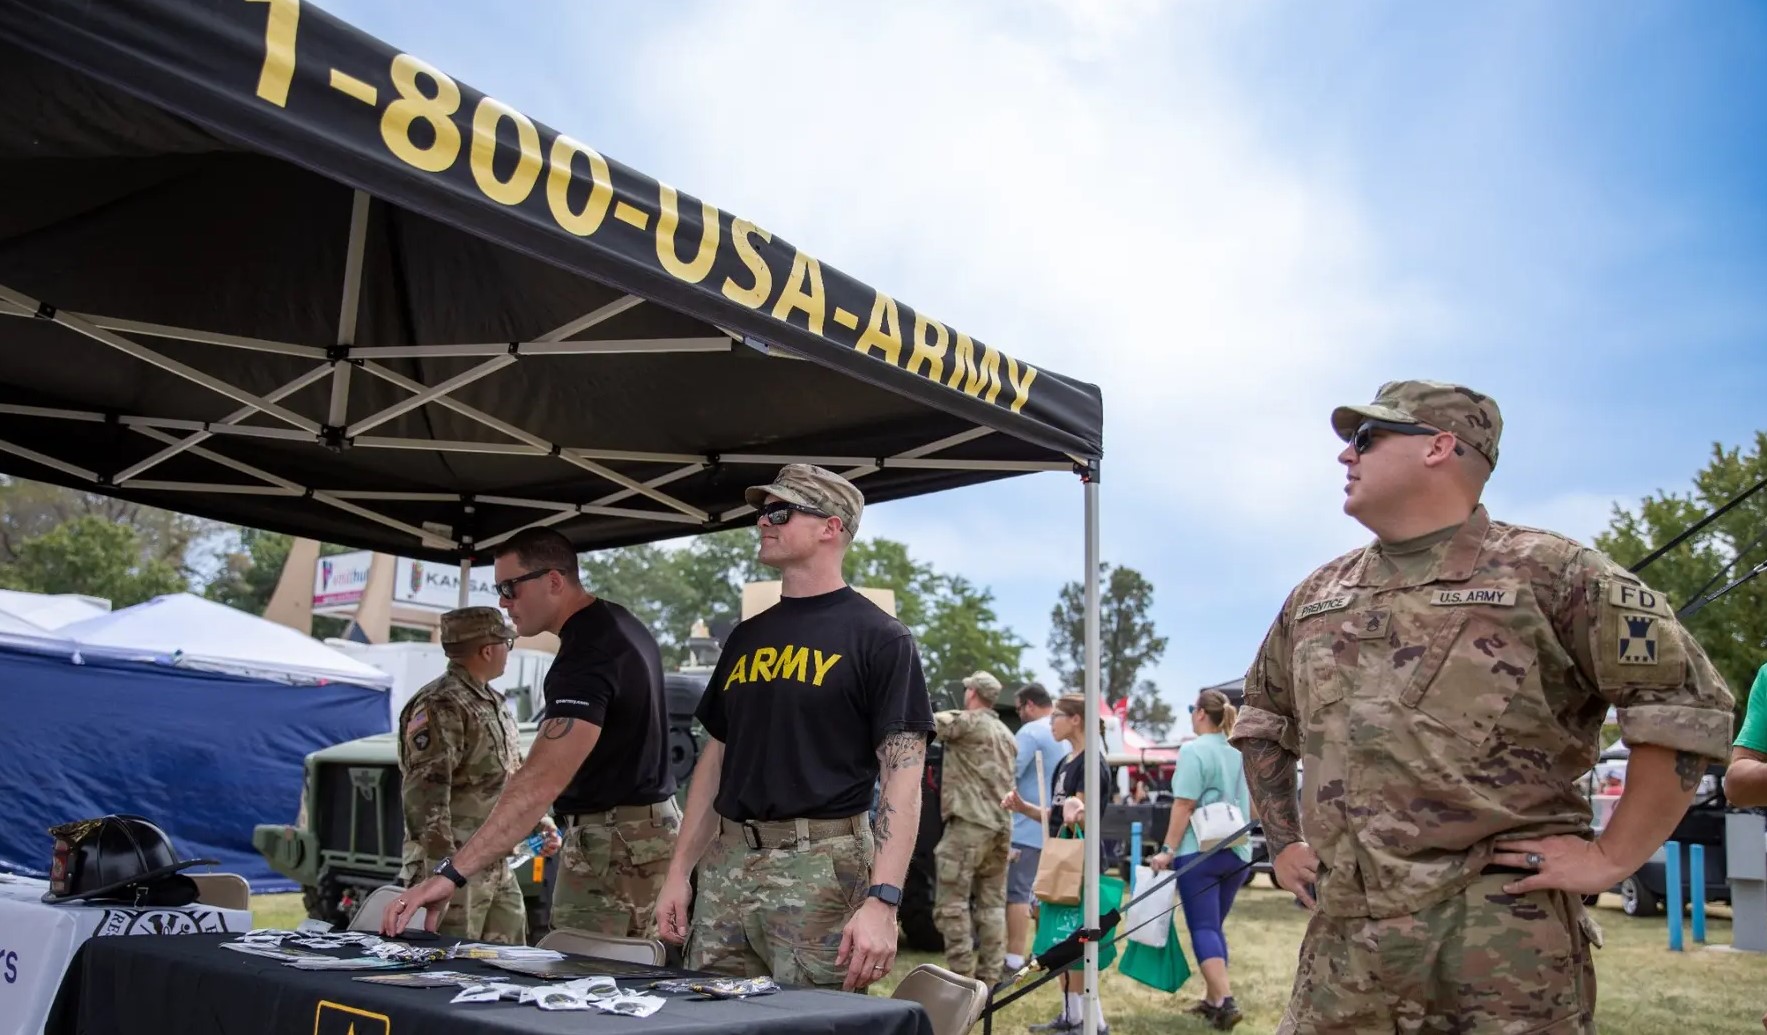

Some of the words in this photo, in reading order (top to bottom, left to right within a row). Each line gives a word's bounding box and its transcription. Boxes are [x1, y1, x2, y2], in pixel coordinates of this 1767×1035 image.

[245, 0, 1037, 413] 1-800-USA-ARMY
[1301, 598, 1345, 616] PRENTICE
[1440, 592, 1462, 602] U.S.
[1466, 591, 1505, 602] ARMY
[1621, 586, 1655, 608] FD
[724, 645, 842, 690] ARMY
